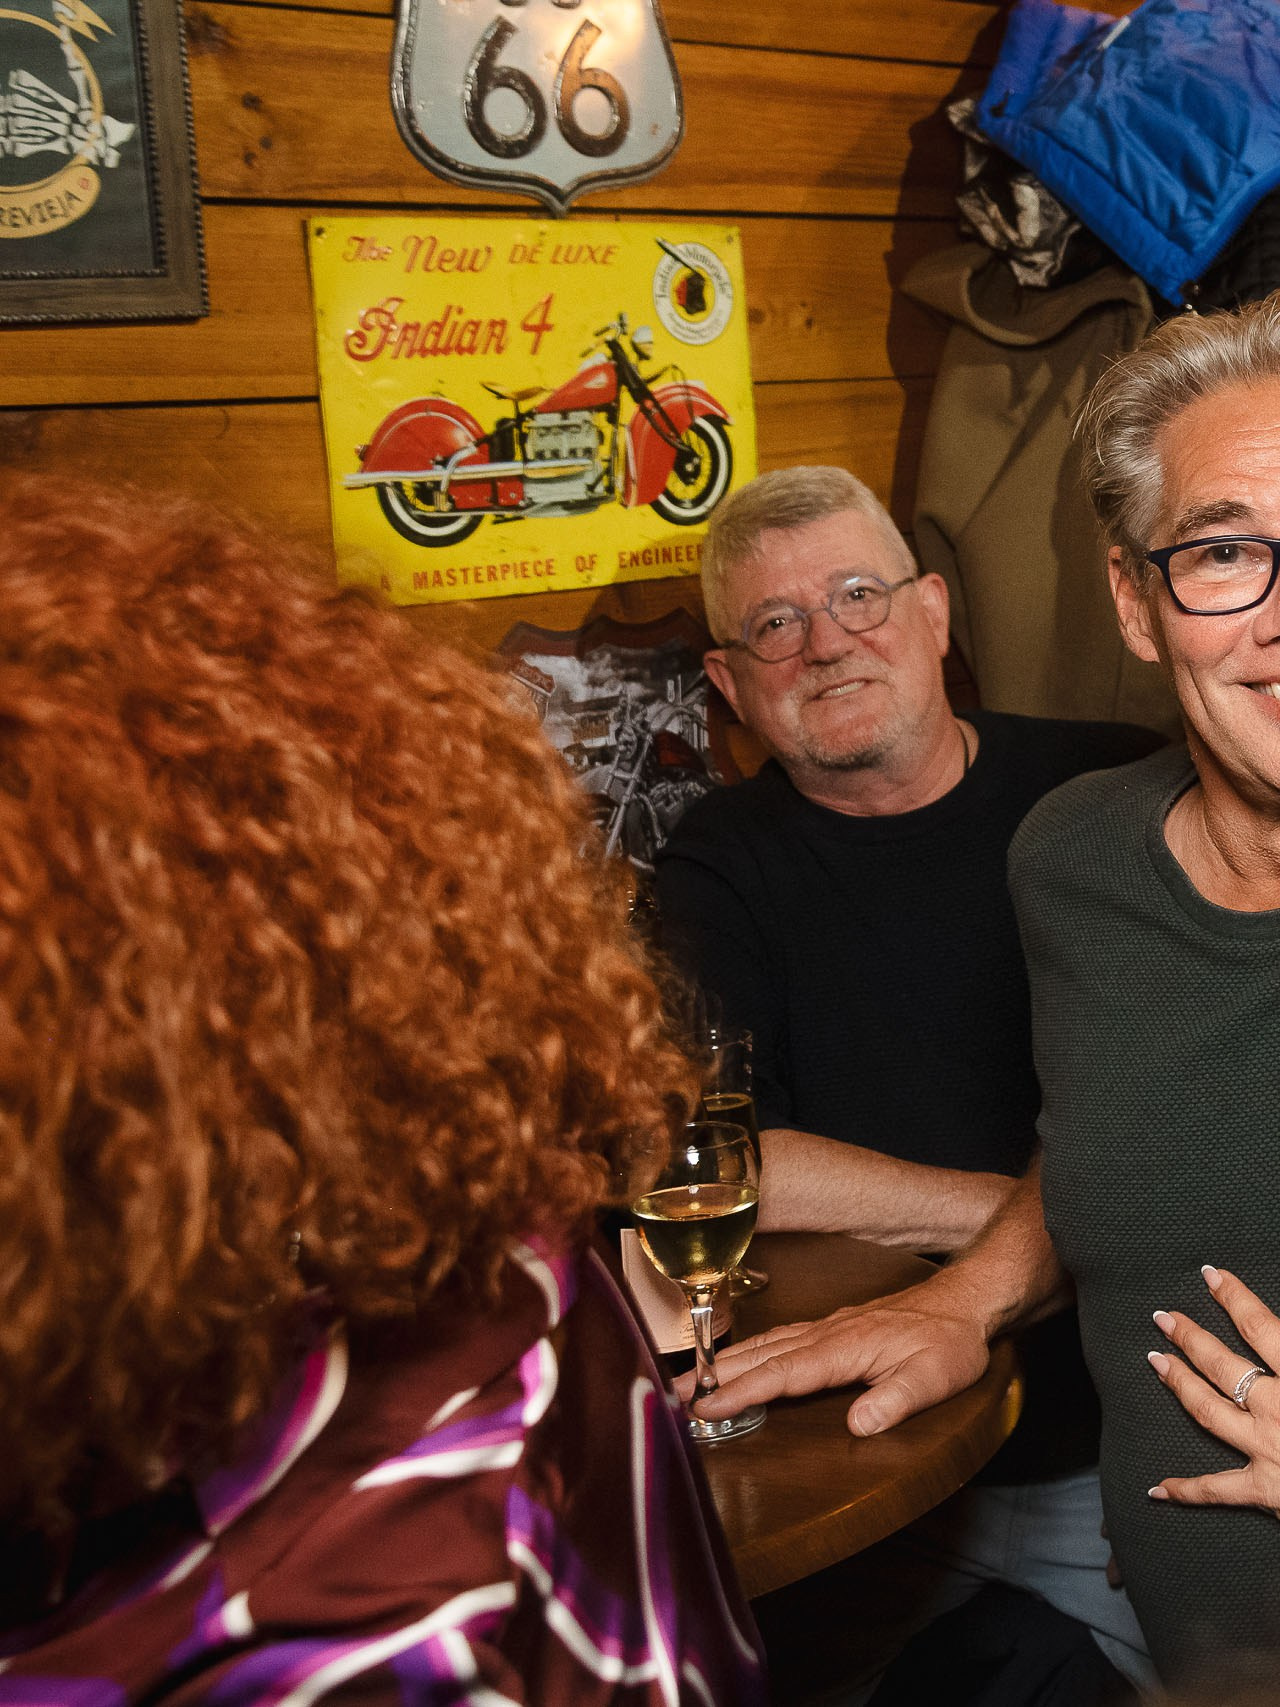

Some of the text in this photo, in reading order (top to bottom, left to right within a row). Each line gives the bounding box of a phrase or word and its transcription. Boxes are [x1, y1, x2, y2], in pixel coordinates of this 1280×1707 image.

[463, 15, 630, 159] 66
[342, 235, 619, 273] The New DE LUXE
[343, 292, 555, 363] Indian 4
[412, 558, 556, 590] MASTERPIECE
[575, 554, 598, 574] OF
